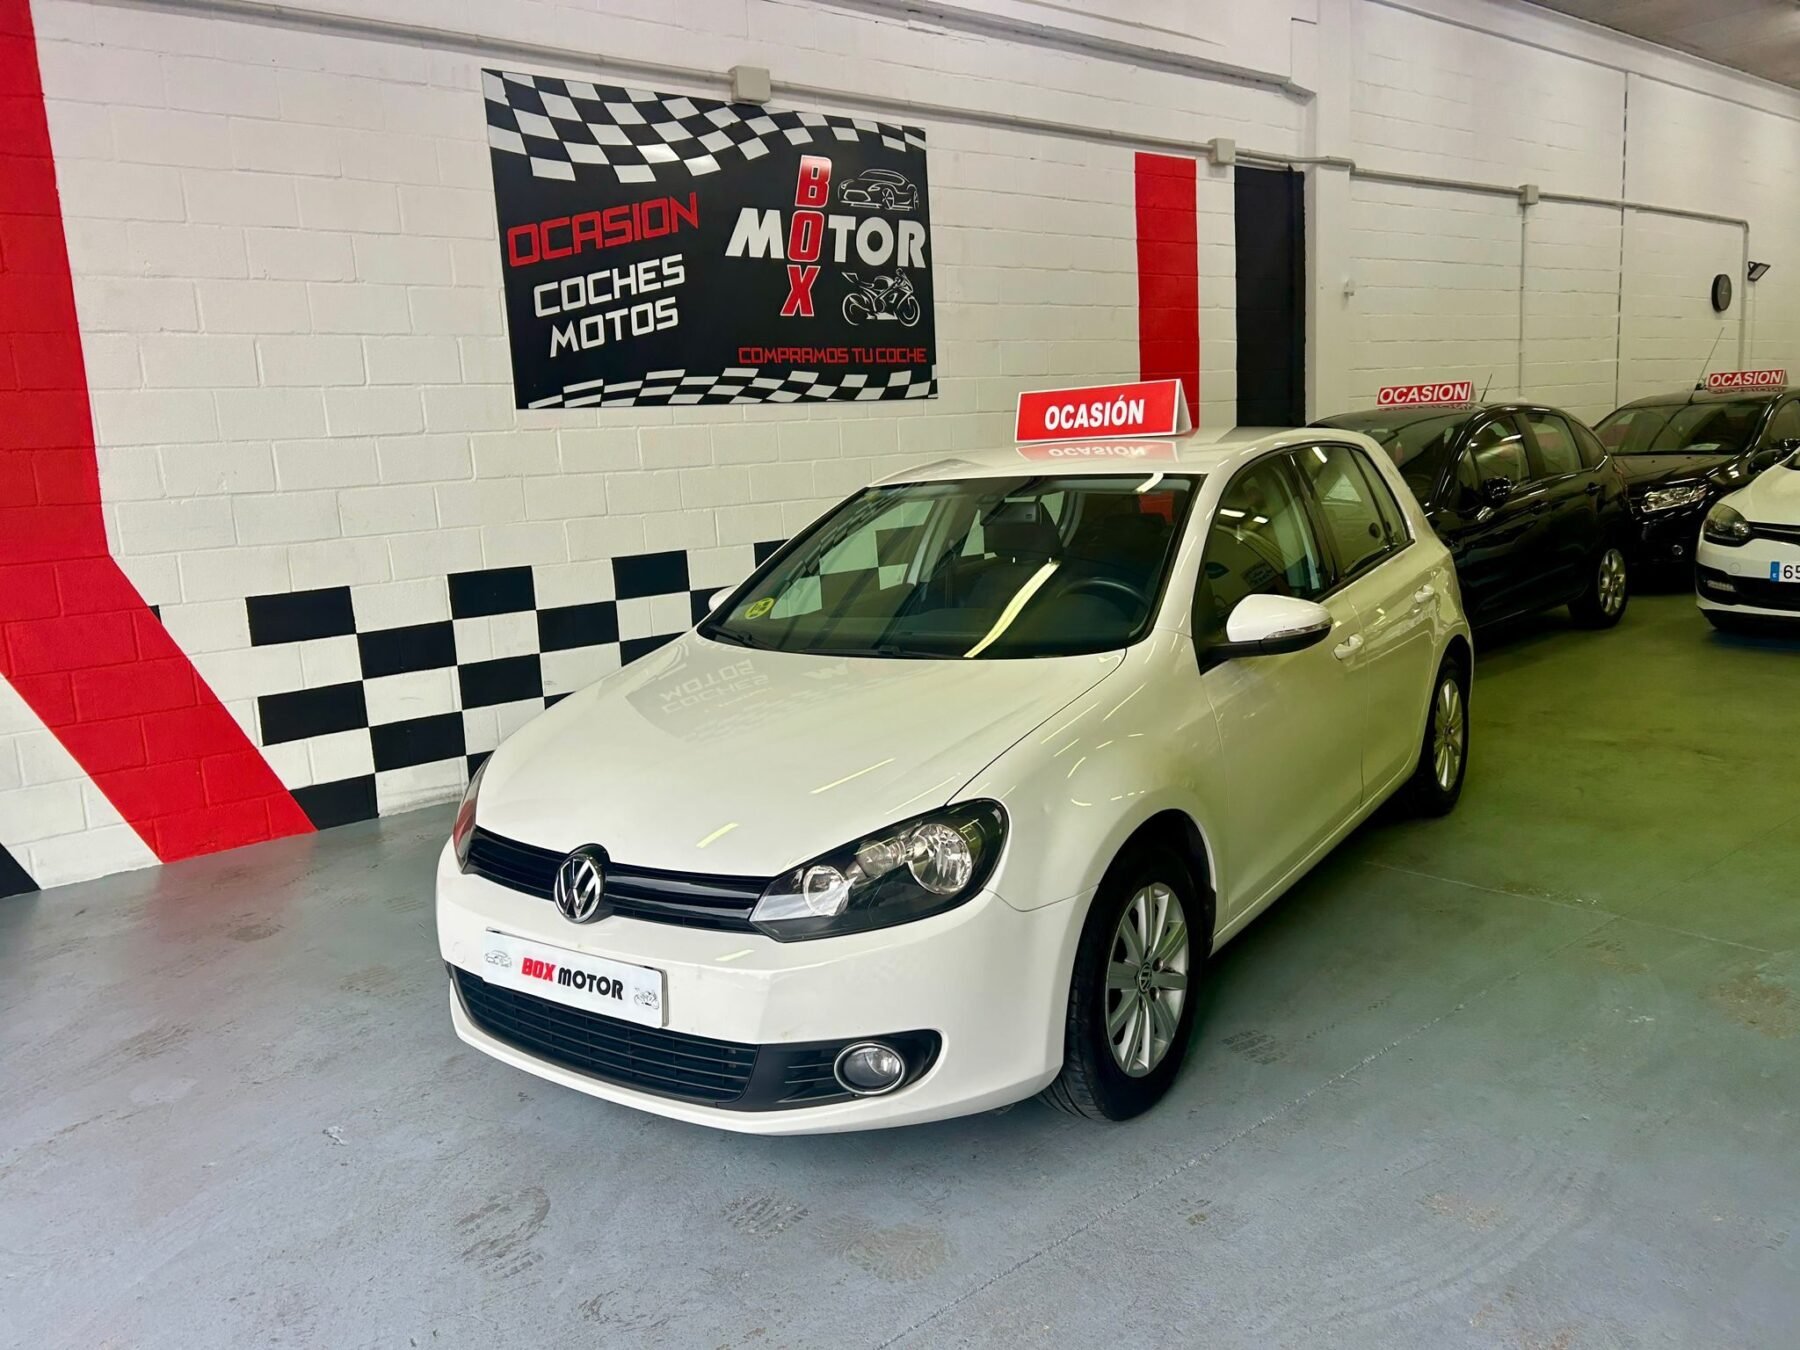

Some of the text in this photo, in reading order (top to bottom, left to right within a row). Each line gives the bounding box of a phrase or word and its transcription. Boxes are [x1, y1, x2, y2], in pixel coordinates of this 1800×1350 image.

[507, 192, 699, 267] OCASION
[725, 207, 926, 268] MOTOR
[780, 154, 832, 318] BOX
[533, 253, 685, 318] COCHES
[549, 296, 678, 358] MOTOS
[738, 347, 927, 363] COMPRAMOS TU COCHE
[1709, 371, 1782, 386] OCASION
[1044, 394, 1145, 430] OCASIÓN
[1379, 383, 1468, 403] OCASION
[521, 957, 623, 1000] BOX MOTOR
